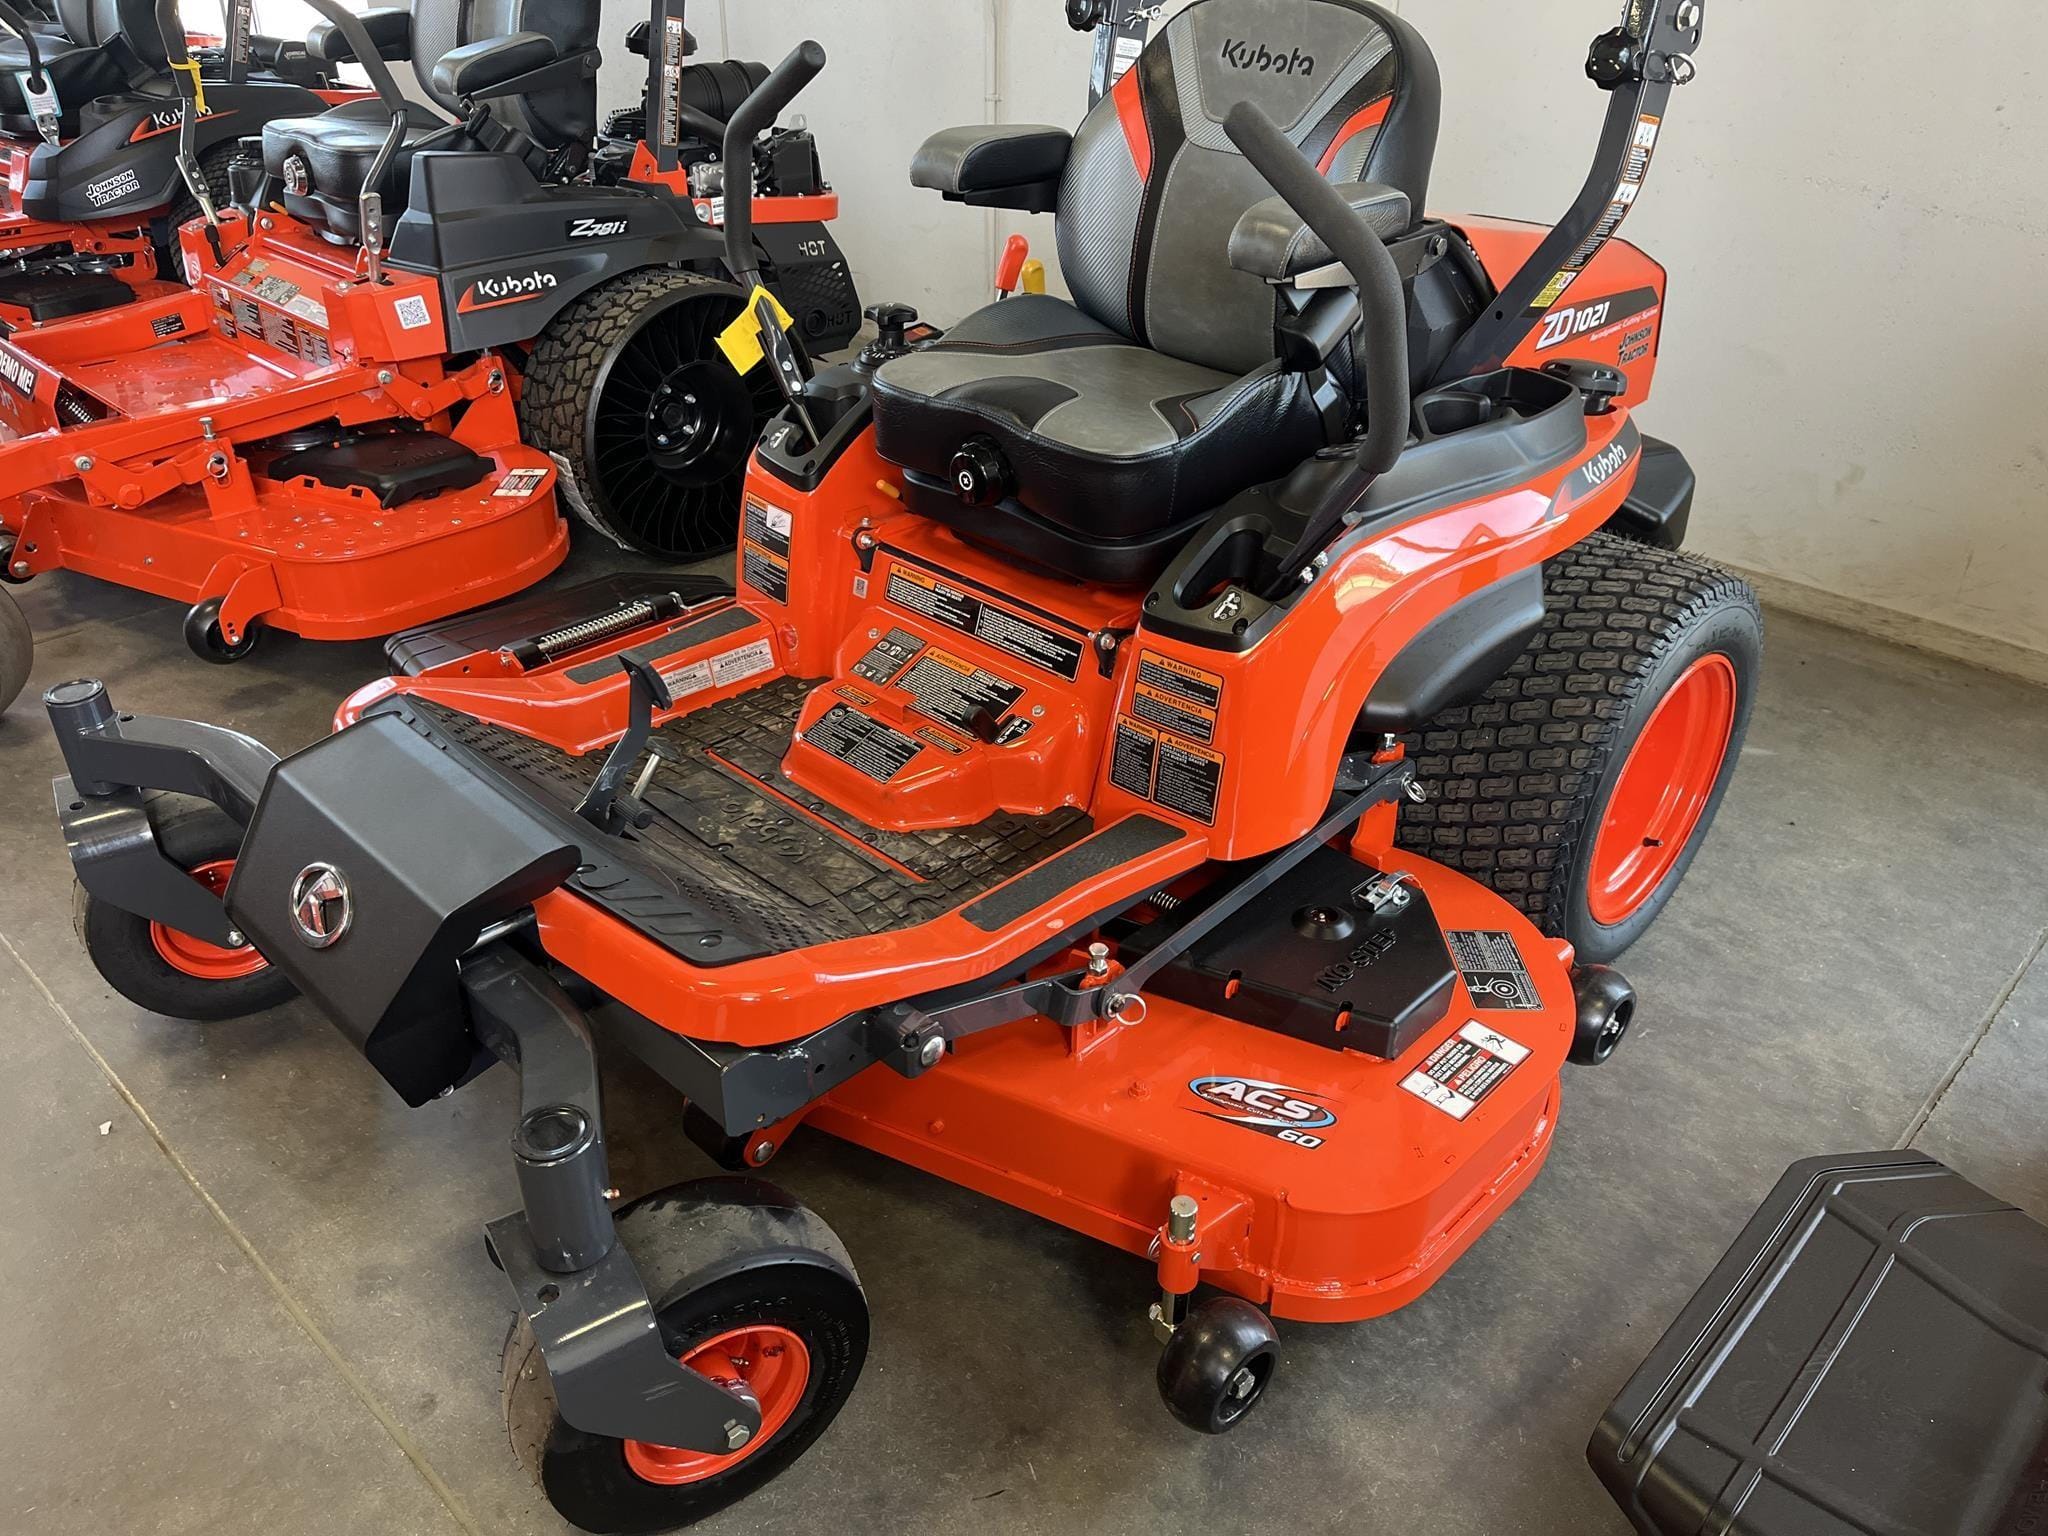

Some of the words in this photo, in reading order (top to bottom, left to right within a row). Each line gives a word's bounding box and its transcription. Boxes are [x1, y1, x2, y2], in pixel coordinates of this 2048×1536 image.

[1221, 38, 1315, 76] Kubota
[86, 170, 135, 197] JOHNSON
[91, 180, 140, 207] TRACTOR
[798, 240, 826, 256] HOT
[477, 270, 558, 298] Kubota
[1535, 301, 1611, 350] ZD1021
[1618, 325, 1653, 350] JOHNSON
[1617, 343, 1649, 366] TRACTOR
[17, 366, 35, 395] ME!
[1582, 442, 1627, 484] Kubota
[903, 568, 926, 584] WARNING
[724, 650, 758, 667] ADVERTENCIA
[935, 650, 971, 673] ADVERTENCIA
[1166, 661, 1202, 679] WARNING
[1154, 691, 1203, 715] ADVERTENCIA
[1174, 740, 1216, 759] ADVERTENCIA
[1314, 962, 1355, 992] NO
[1347, 927, 1398, 968] STEP
[1429, 1038, 1458, 1065] DANGER
[1458, 1055, 1487, 1081] PELIGRO
[1206, 1080, 1319, 1121] ACS
[1277, 1129, 1322, 1149] 60
